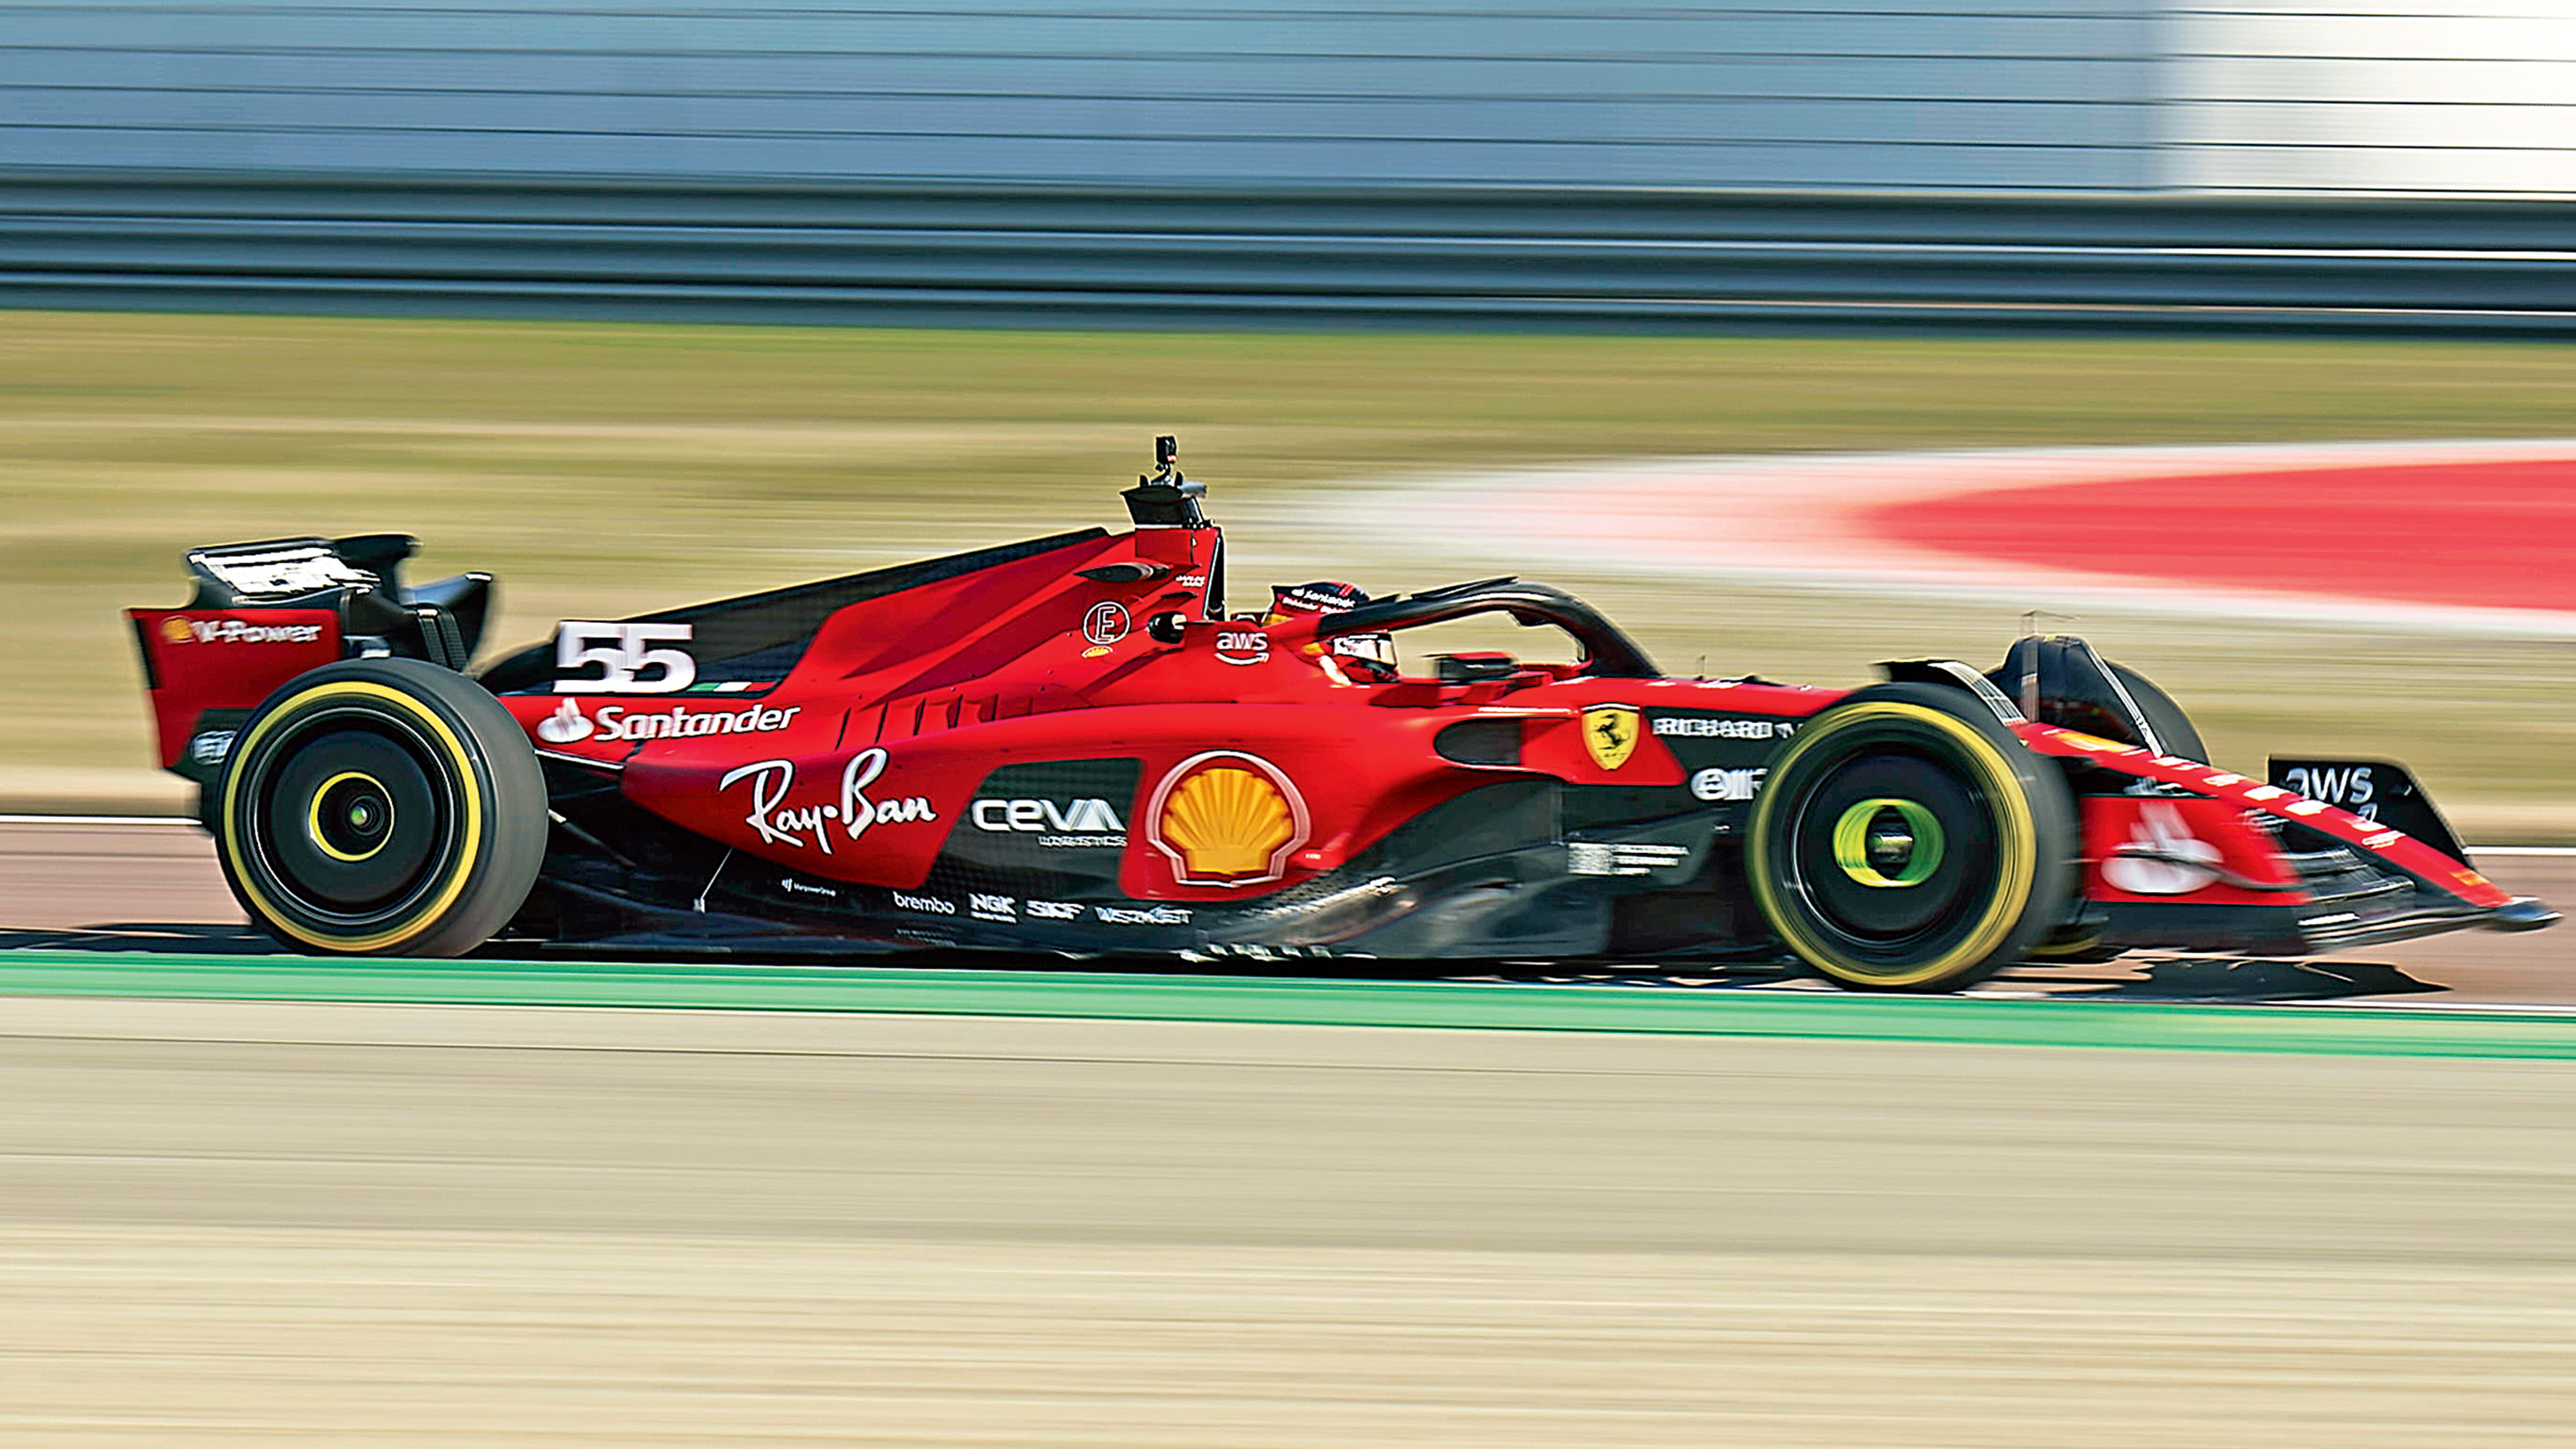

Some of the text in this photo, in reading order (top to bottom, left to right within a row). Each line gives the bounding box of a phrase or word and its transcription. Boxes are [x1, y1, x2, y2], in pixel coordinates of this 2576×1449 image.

[190, 620, 322, 643] V-Power
[1216, 631, 1268, 651] aws
[552, 621, 696, 693] 55
[593, 704, 801, 741] Santander
[1653, 716, 1773, 739] RICHARD
[893, 890, 956, 915] brembo
[968, 892, 1017, 915] NGK
